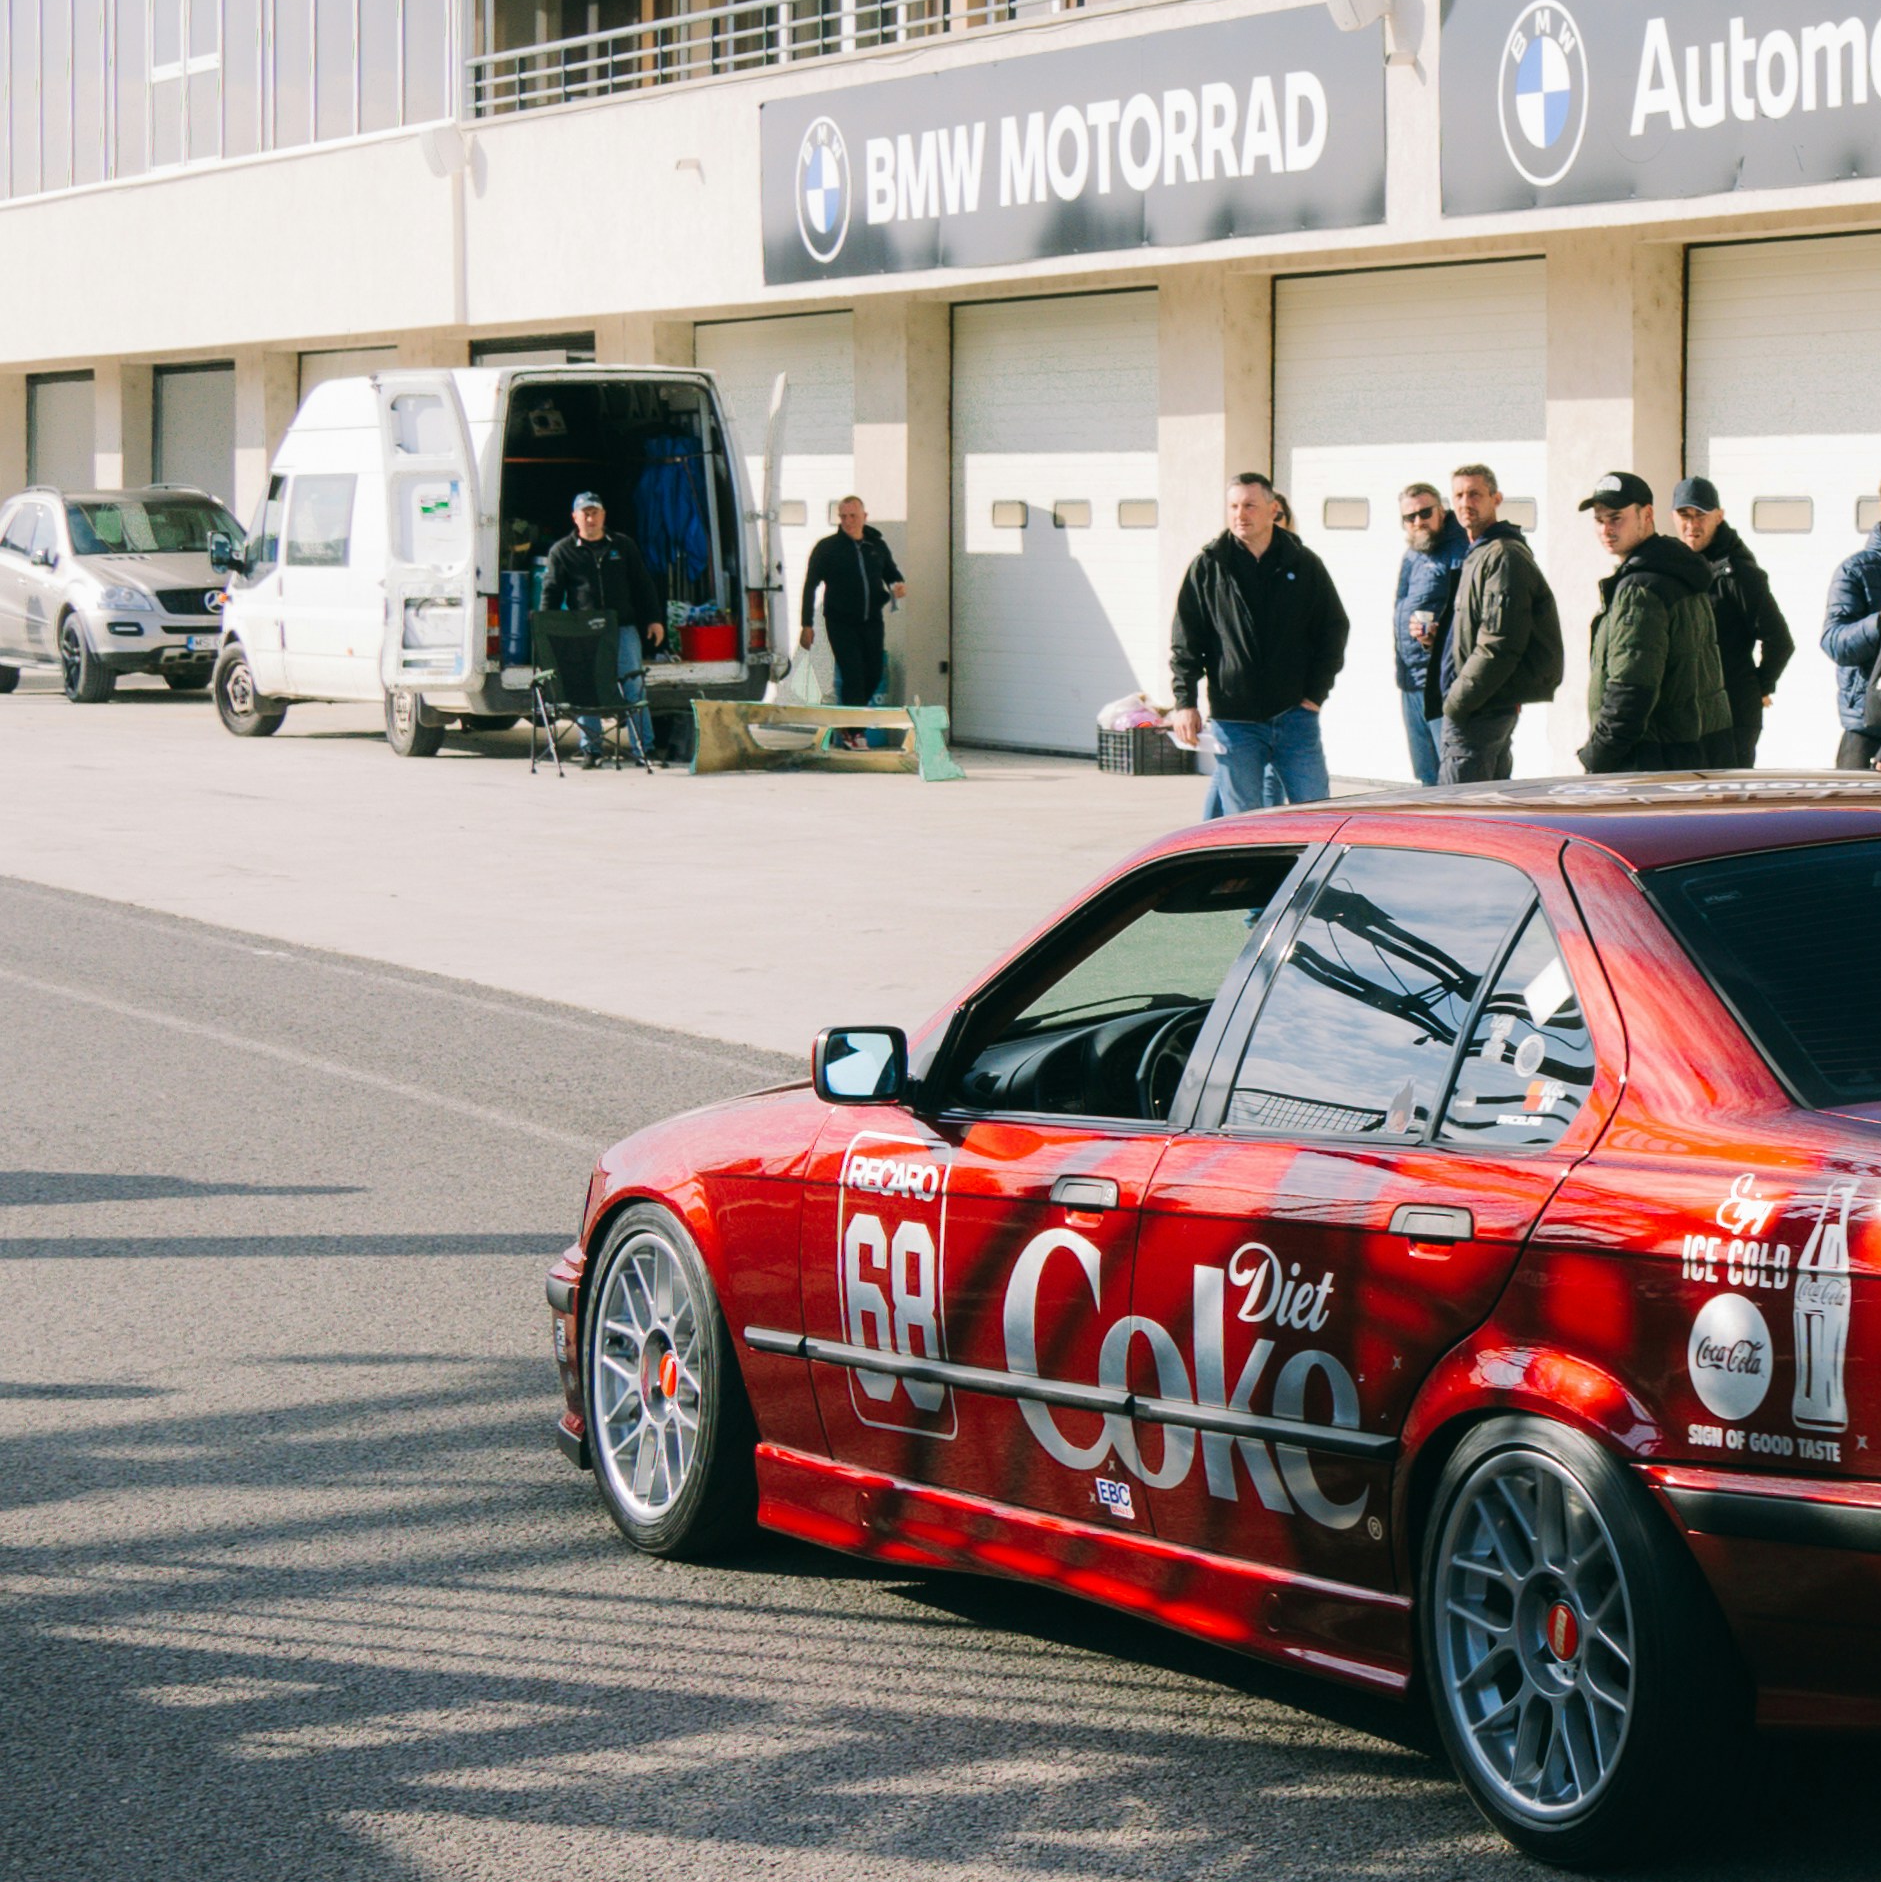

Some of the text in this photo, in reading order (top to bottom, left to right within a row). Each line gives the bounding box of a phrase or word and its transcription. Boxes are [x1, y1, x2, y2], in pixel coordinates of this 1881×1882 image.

[1511, 9, 1575, 64] BMW
[865, 70, 1327, 225] BMW MOTORRAD
[847, 1155, 939, 1202] RECARO
[1228, 1242, 1334, 1332] Diet
[1681, 1234, 1791, 1290] ICE COLD
[845, 1212, 946, 1412] 68
[1004, 1228, 1369, 1530] Coke
[1688, 1423, 1841, 1462] SIGN OF GOOD TASTE
[1099, 1481, 1130, 1506] EBC
